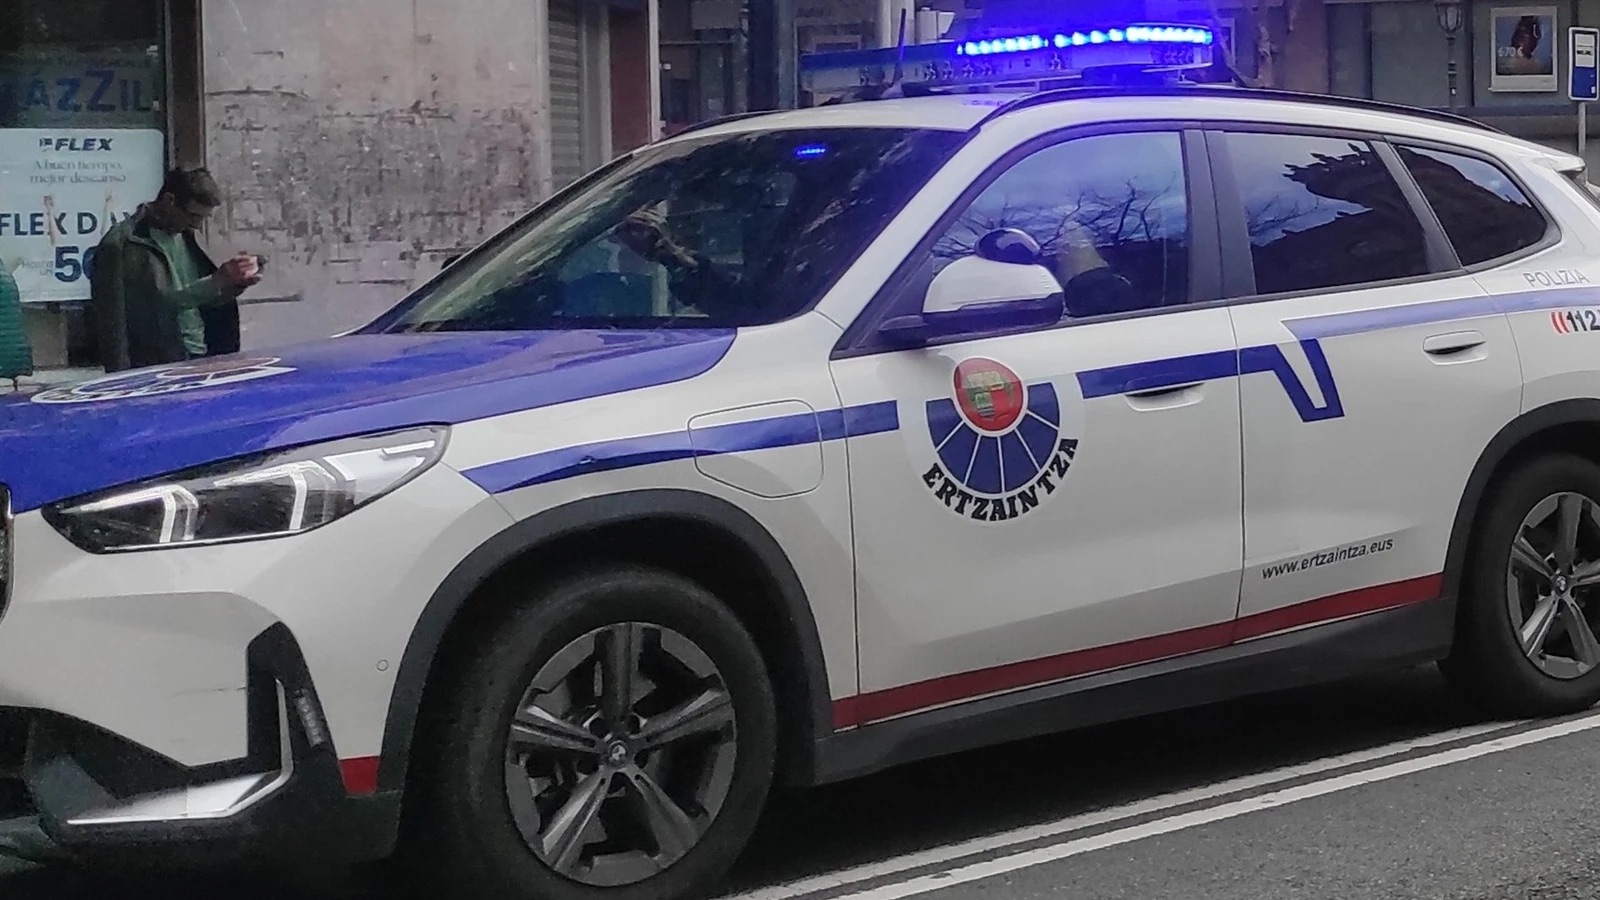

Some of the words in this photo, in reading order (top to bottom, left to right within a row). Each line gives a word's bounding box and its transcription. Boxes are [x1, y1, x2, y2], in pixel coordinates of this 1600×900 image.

[55, 138, 113, 151] FLEX
[30, 174, 67, 187] mejor
[70, 171, 127, 183] descanso
[0, 212, 68, 236] FLEX
[1522, 269, 1591, 287] POLIZIA
[1566, 310, 1600, 332] 112
[921, 438, 1079, 521] ERTZAINTZA
[1262, 539, 1394, 579] www.ertzaintza.eus
